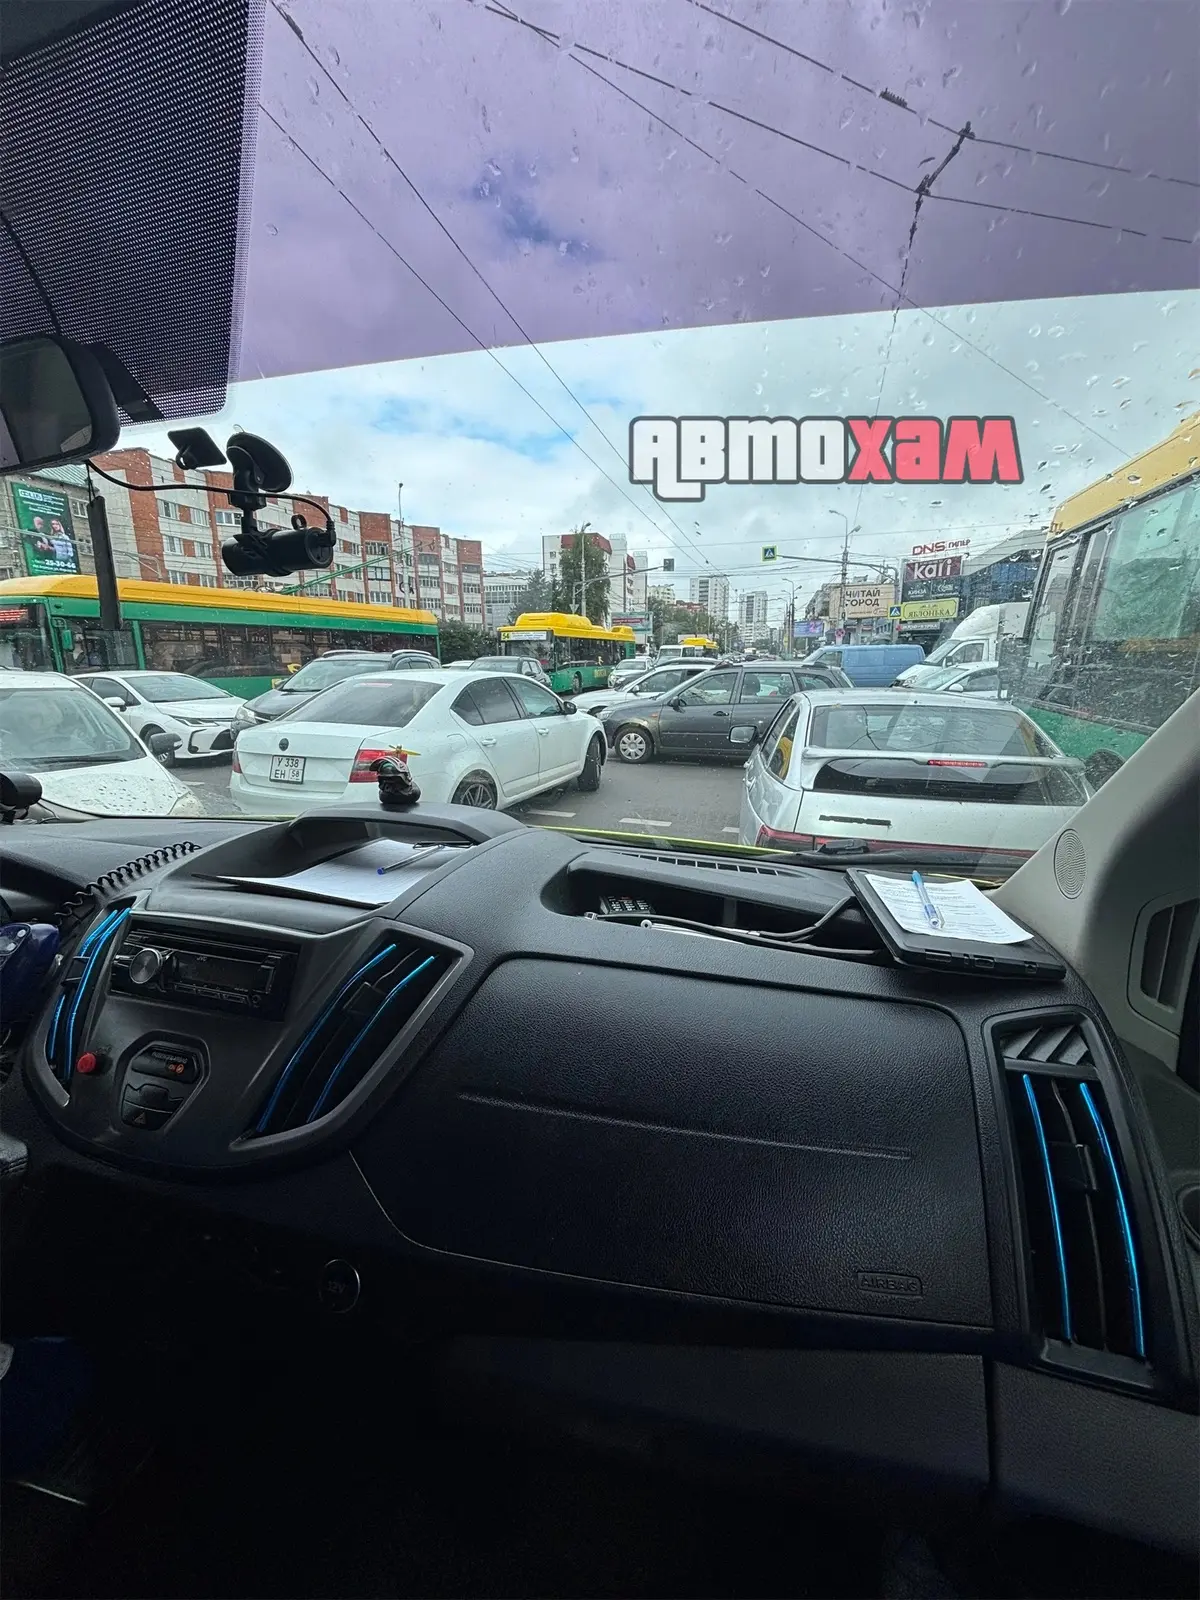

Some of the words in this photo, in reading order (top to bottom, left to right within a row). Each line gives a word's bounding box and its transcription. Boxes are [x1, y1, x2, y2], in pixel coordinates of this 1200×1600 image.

[912, 541, 945, 556] DNS
[913, 558, 952, 580] kari
[845, 587, 880, 598] ЧИТАЙ
[908, 609, 951, 618] ЯБЛОНЬКА
[284, 758, 300, 768] 338
[291, 770, 300, 778] 58
